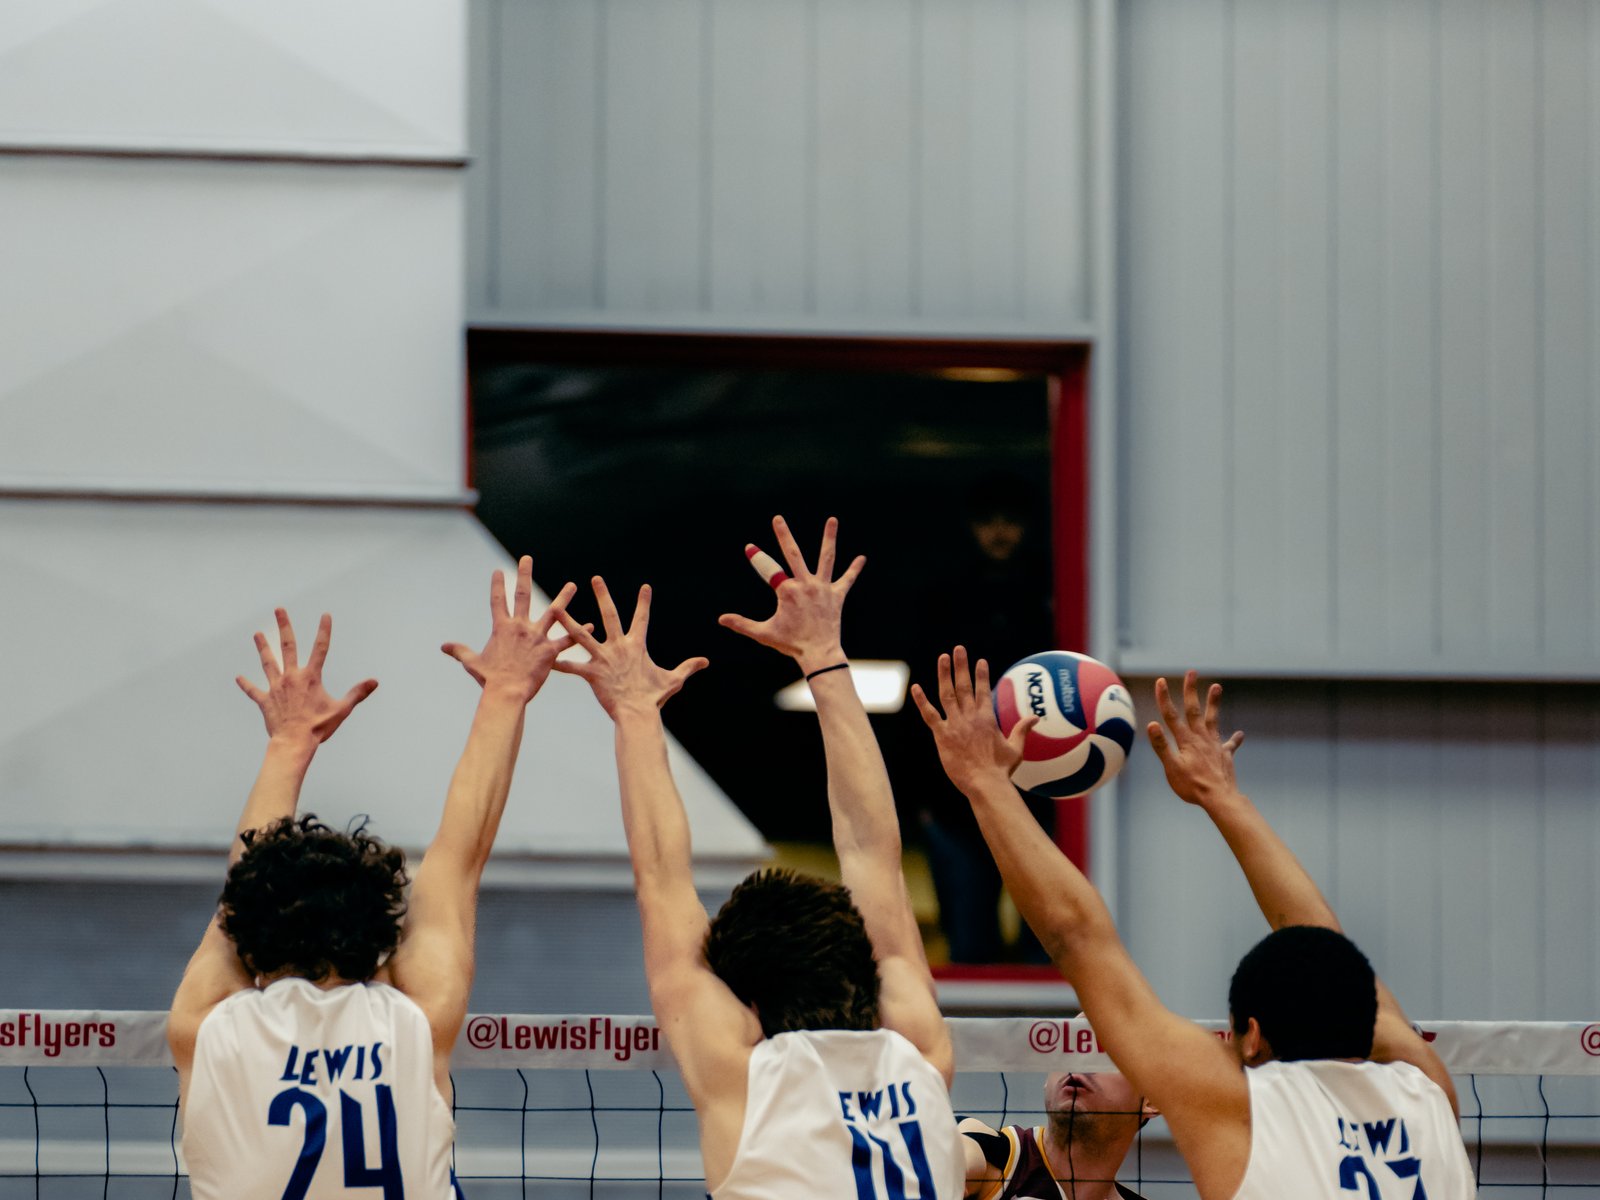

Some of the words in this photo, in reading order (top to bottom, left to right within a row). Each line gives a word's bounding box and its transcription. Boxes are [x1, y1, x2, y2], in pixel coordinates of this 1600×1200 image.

[1025, 671, 1047, 718] NCAA
[1058, 668, 1075, 713] molten
[467, 1016, 661, 1061] @LewisFlyer
[279, 1042, 384, 1086] LEWIS
[838, 1081, 917, 1122] EWIS
